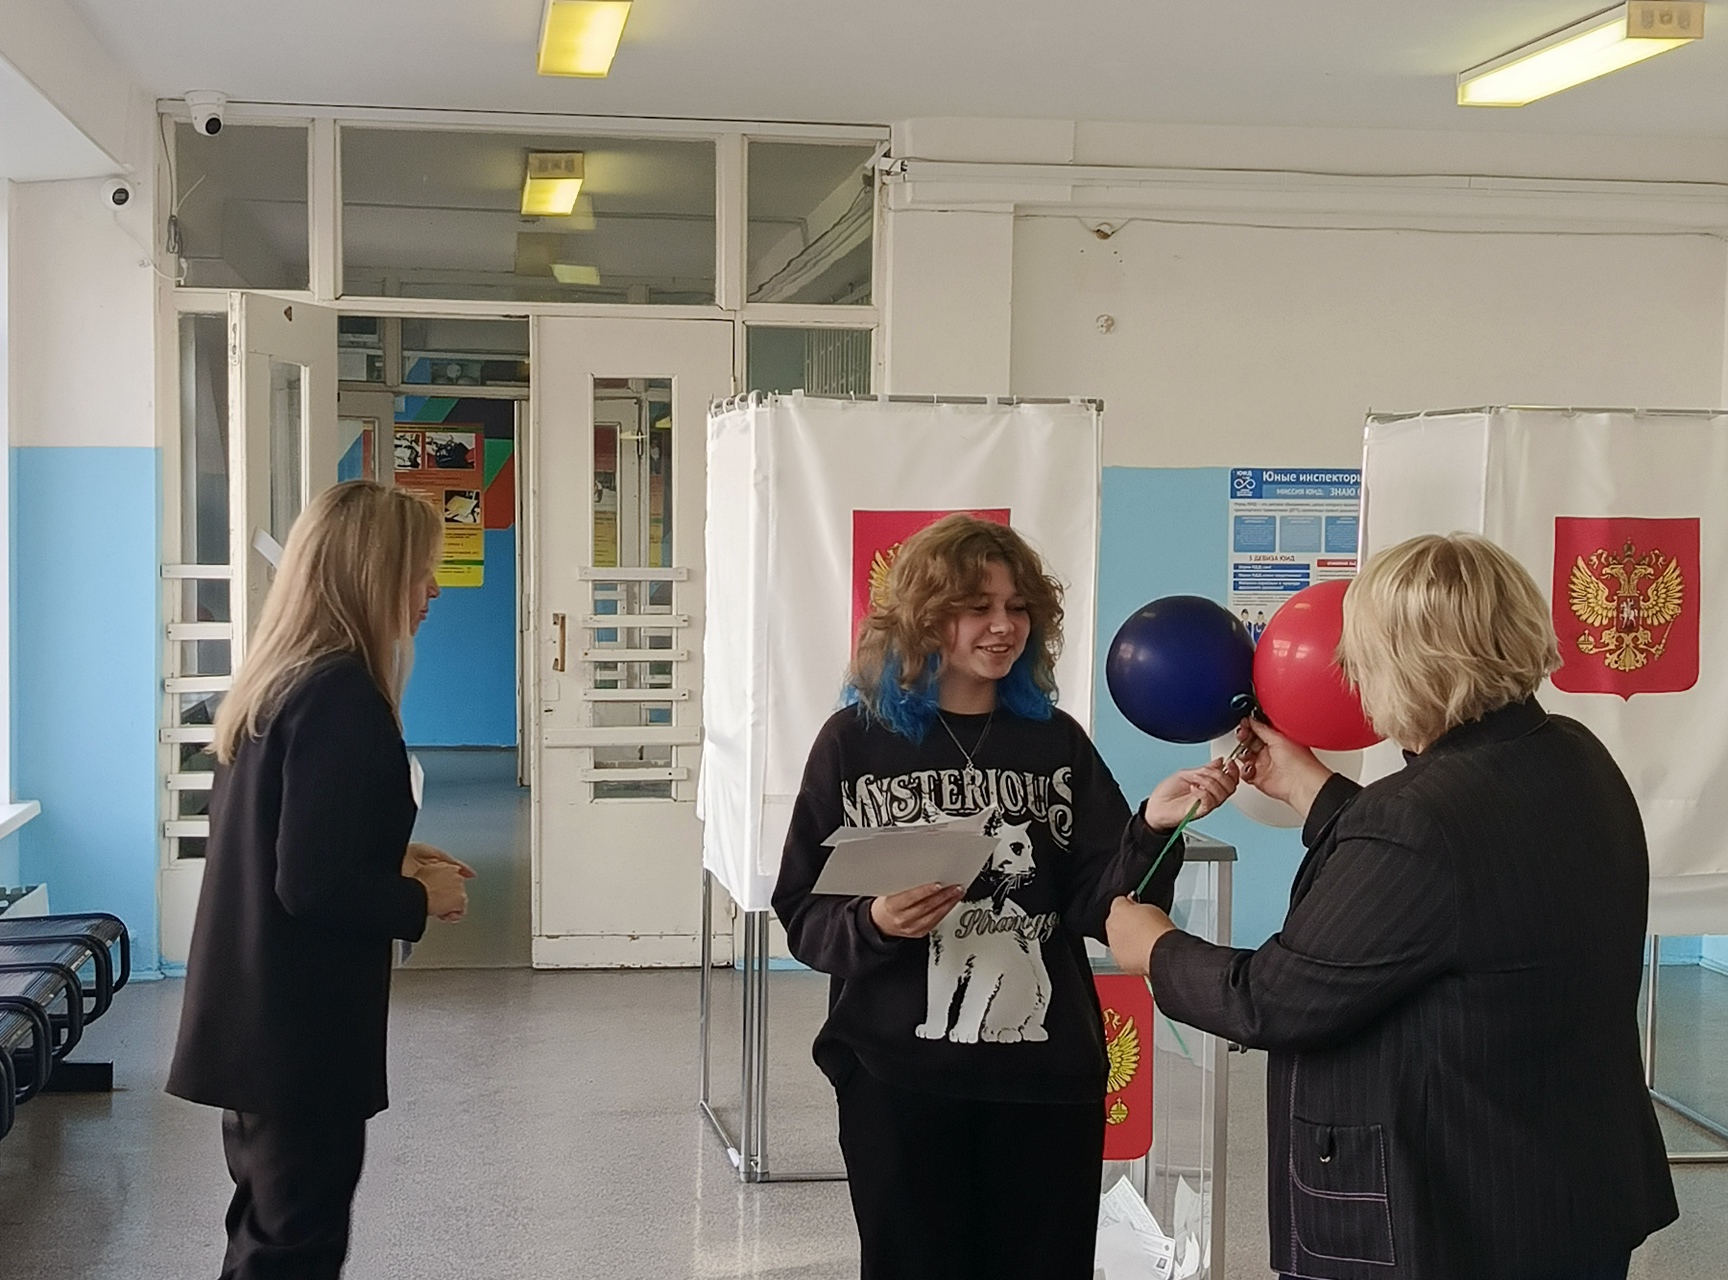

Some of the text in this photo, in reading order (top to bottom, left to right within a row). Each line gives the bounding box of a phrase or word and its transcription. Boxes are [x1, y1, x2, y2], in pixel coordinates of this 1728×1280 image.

[1262, 470, 1297, 482] Юные
[1329, 487, 1356, 497] ЗНАЮ
[841, 767, 1073, 853] MYSTERIOUS
